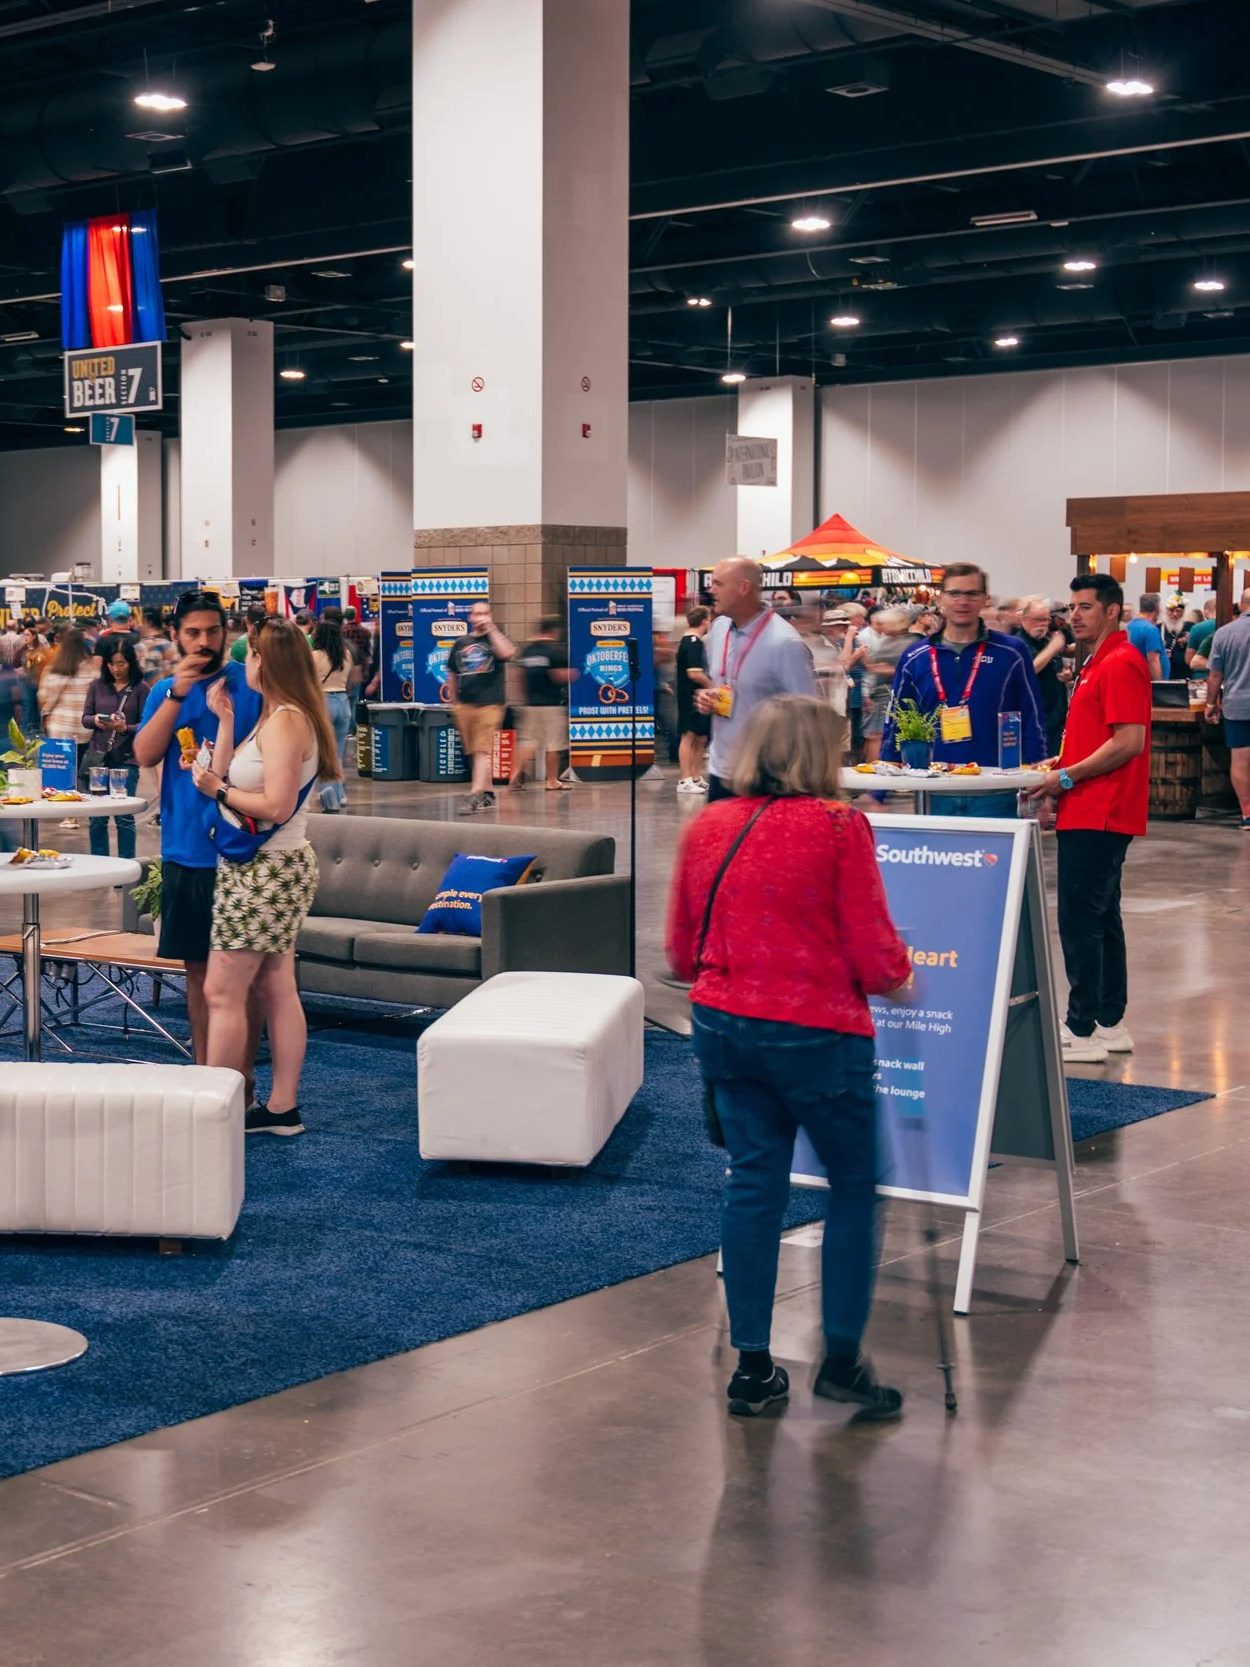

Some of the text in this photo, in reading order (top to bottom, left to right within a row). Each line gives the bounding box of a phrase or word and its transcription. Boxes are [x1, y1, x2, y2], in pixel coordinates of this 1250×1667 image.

[72, 356, 116, 379] UNITED
[72, 377, 117, 408] BEER
[127, 367, 143, 404] 7
[110, 417, 120, 442] 7
[47, 600, 96, 618] Protect
[434, 624, 466, 632] SNYDER'S
[593, 624, 628, 632] SNYDER'S
[579, 705, 649, 715] PROST WITH PRETELS!
[439, 738, 447, 775] RECYCLE
[876, 844, 983, 867] Southwest
[891, 1006, 917, 1018] enjoy
[918, 1009, 925, 1017] a
[926, 1009, 953, 1020] snack
[876, 1018, 952, 1035] at our Mile High
[873, 1059, 925, 1071] snack wall
[890, 1085, 926, 1100] lounge
